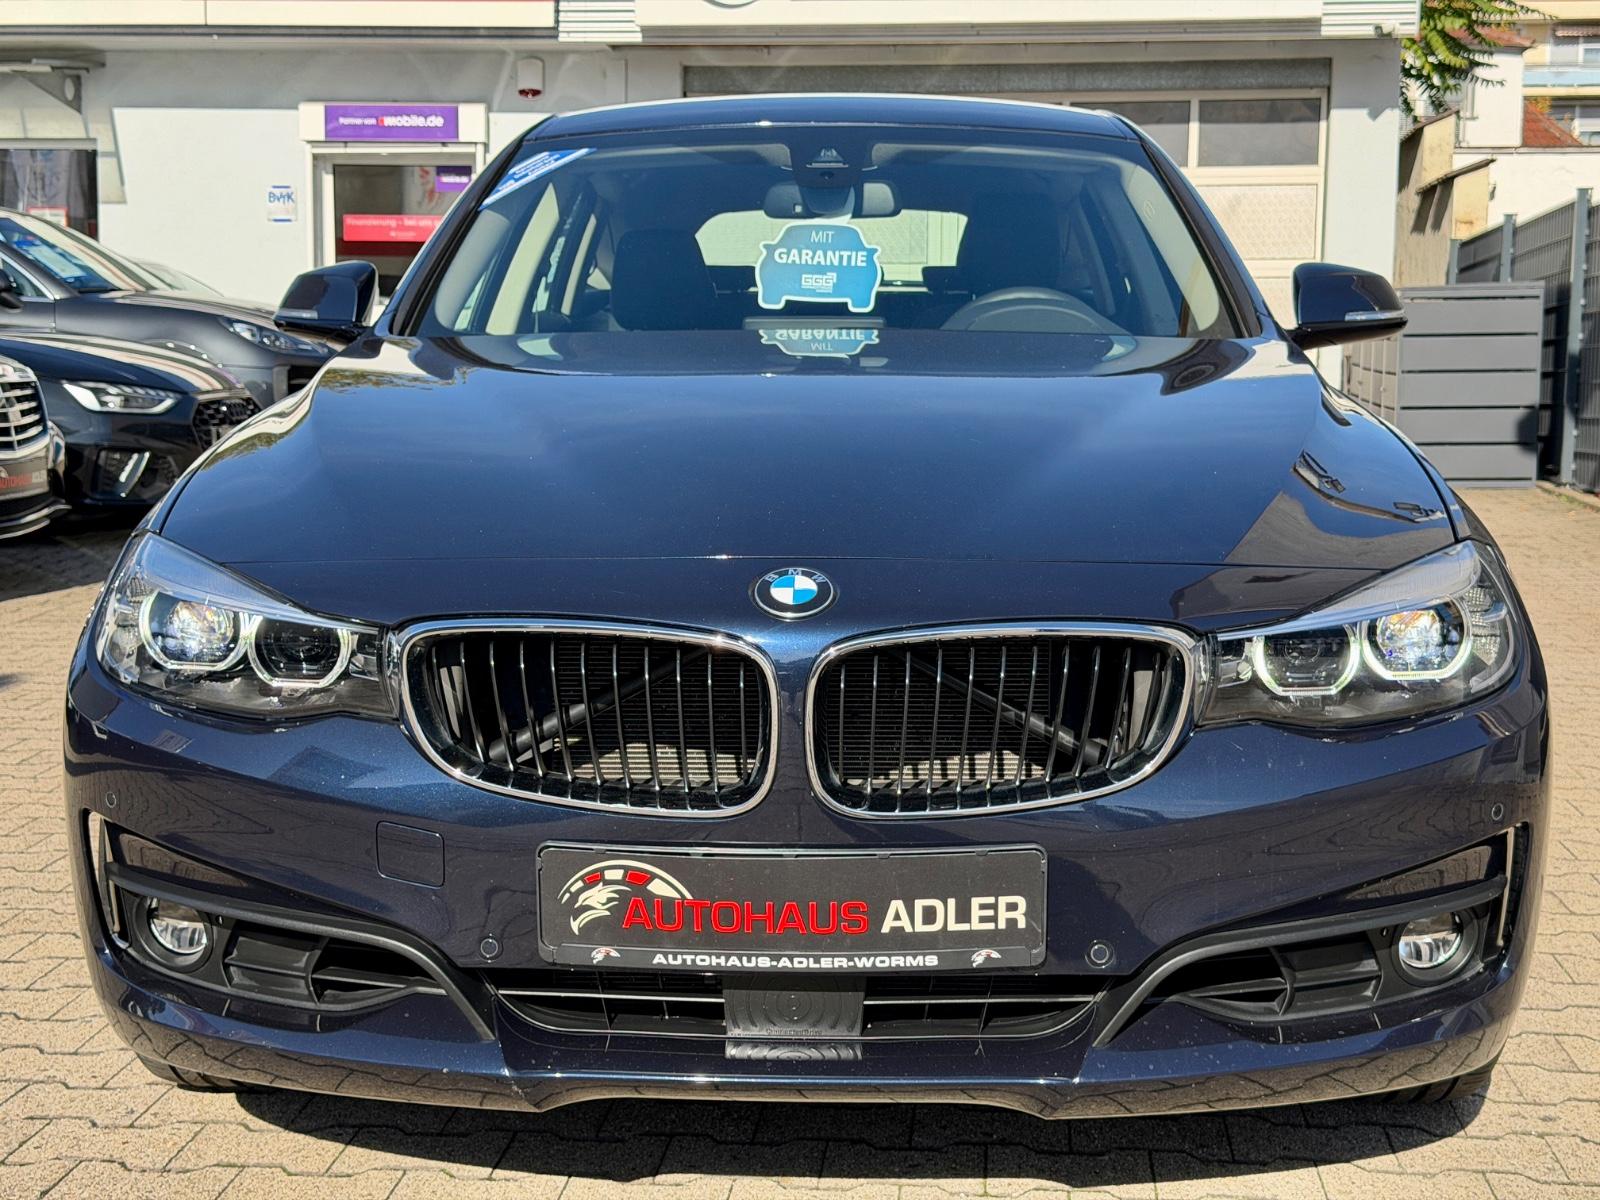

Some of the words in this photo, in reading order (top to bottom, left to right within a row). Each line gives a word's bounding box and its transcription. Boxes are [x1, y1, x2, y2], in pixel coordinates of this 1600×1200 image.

[383, 114, 445, 128] mobile.de
[810, 230, 835, 244] MIT
[773, 248, 868, 267] GARANTIE
[763, 568, 827, 583] BMW
[622, 896, 870, 936] AUTOHAUS
[880, 895, 1027, 934] ADLER
[652, 952, 940, 969] AUTOHAUS-ADLER-WORMS
